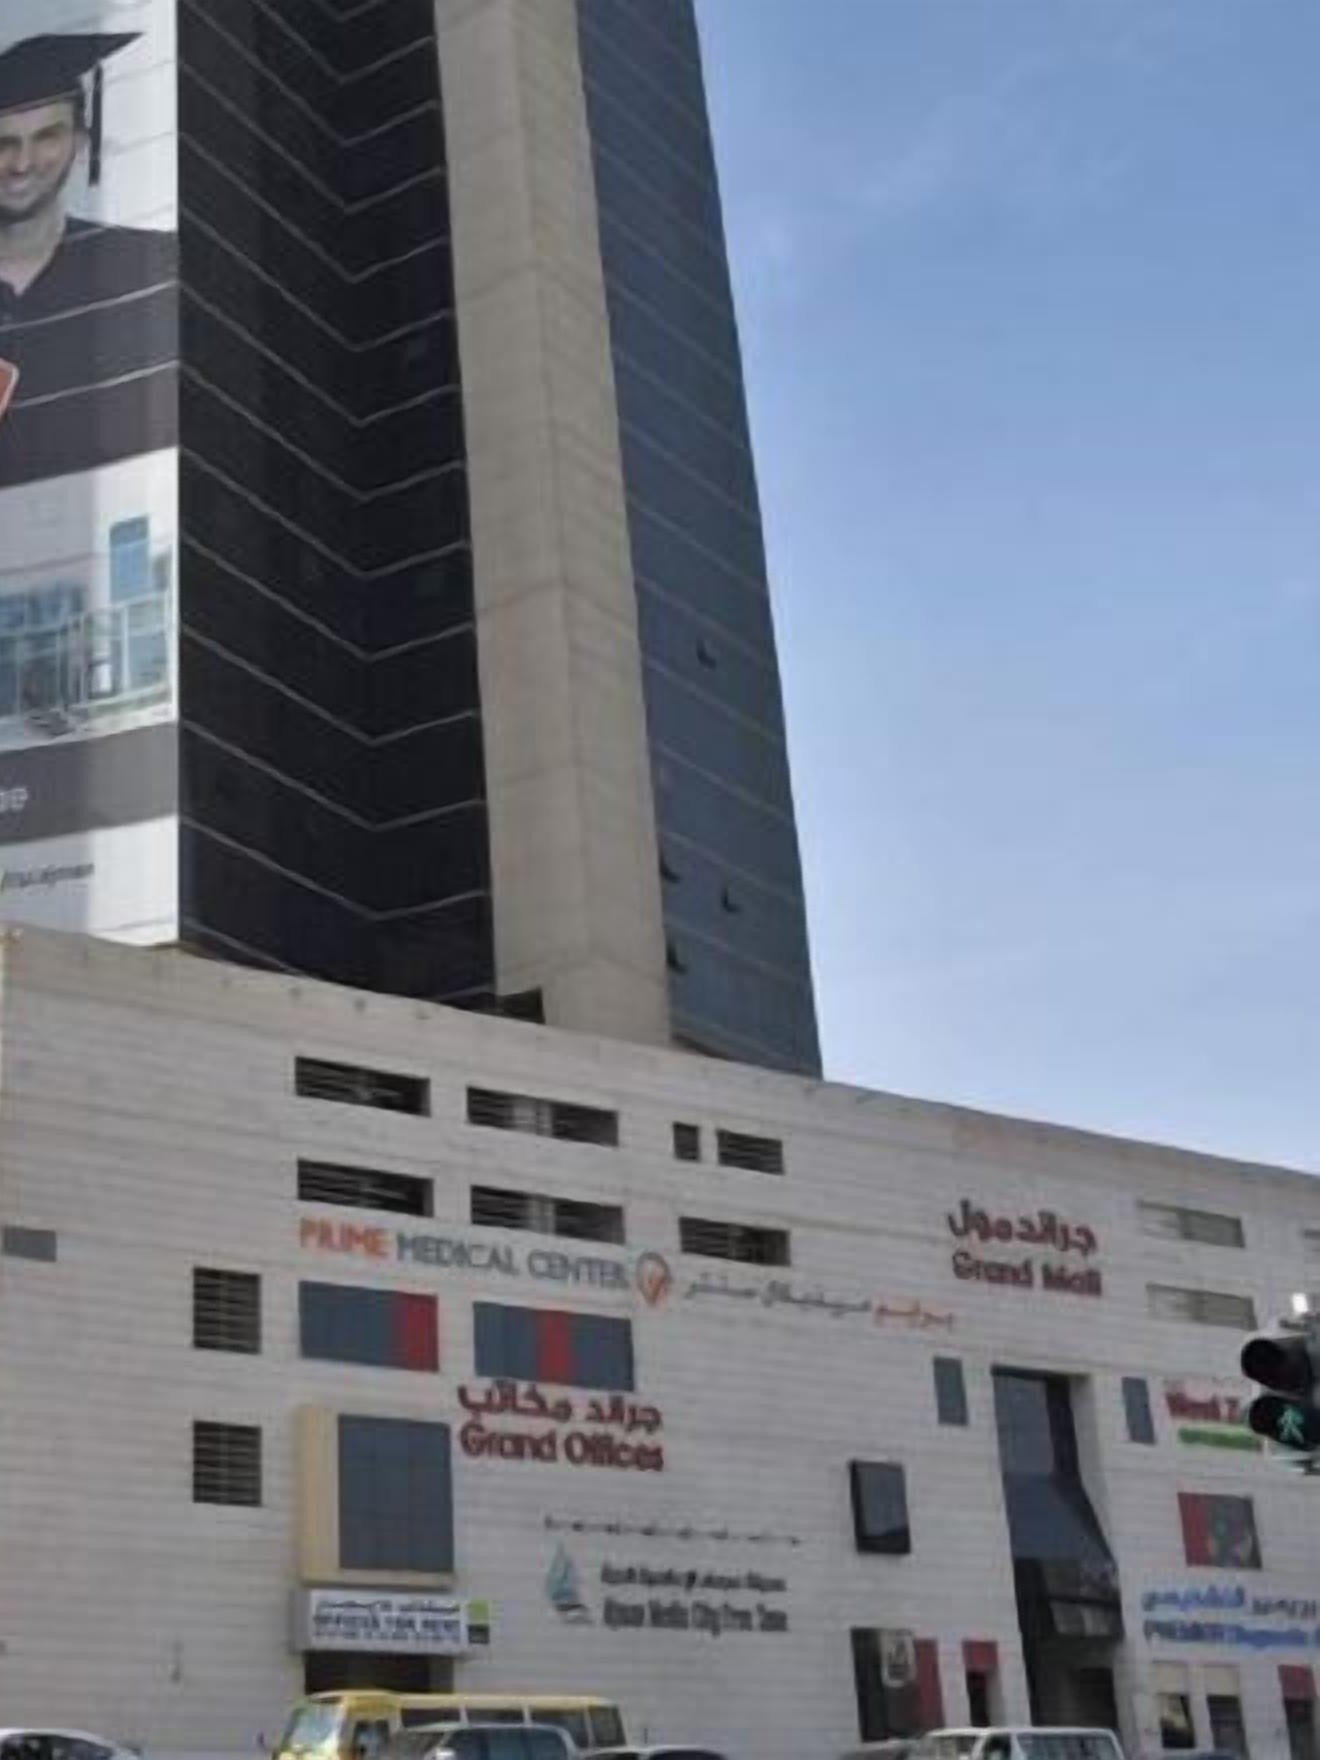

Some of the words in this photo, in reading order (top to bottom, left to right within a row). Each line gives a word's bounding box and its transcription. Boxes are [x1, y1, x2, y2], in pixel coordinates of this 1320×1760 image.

[396, 1232, 521, 1276] MEDICAL
[460, 1423, 558, 1462] Grand
[564, 1432, 664, 1471] Offices
